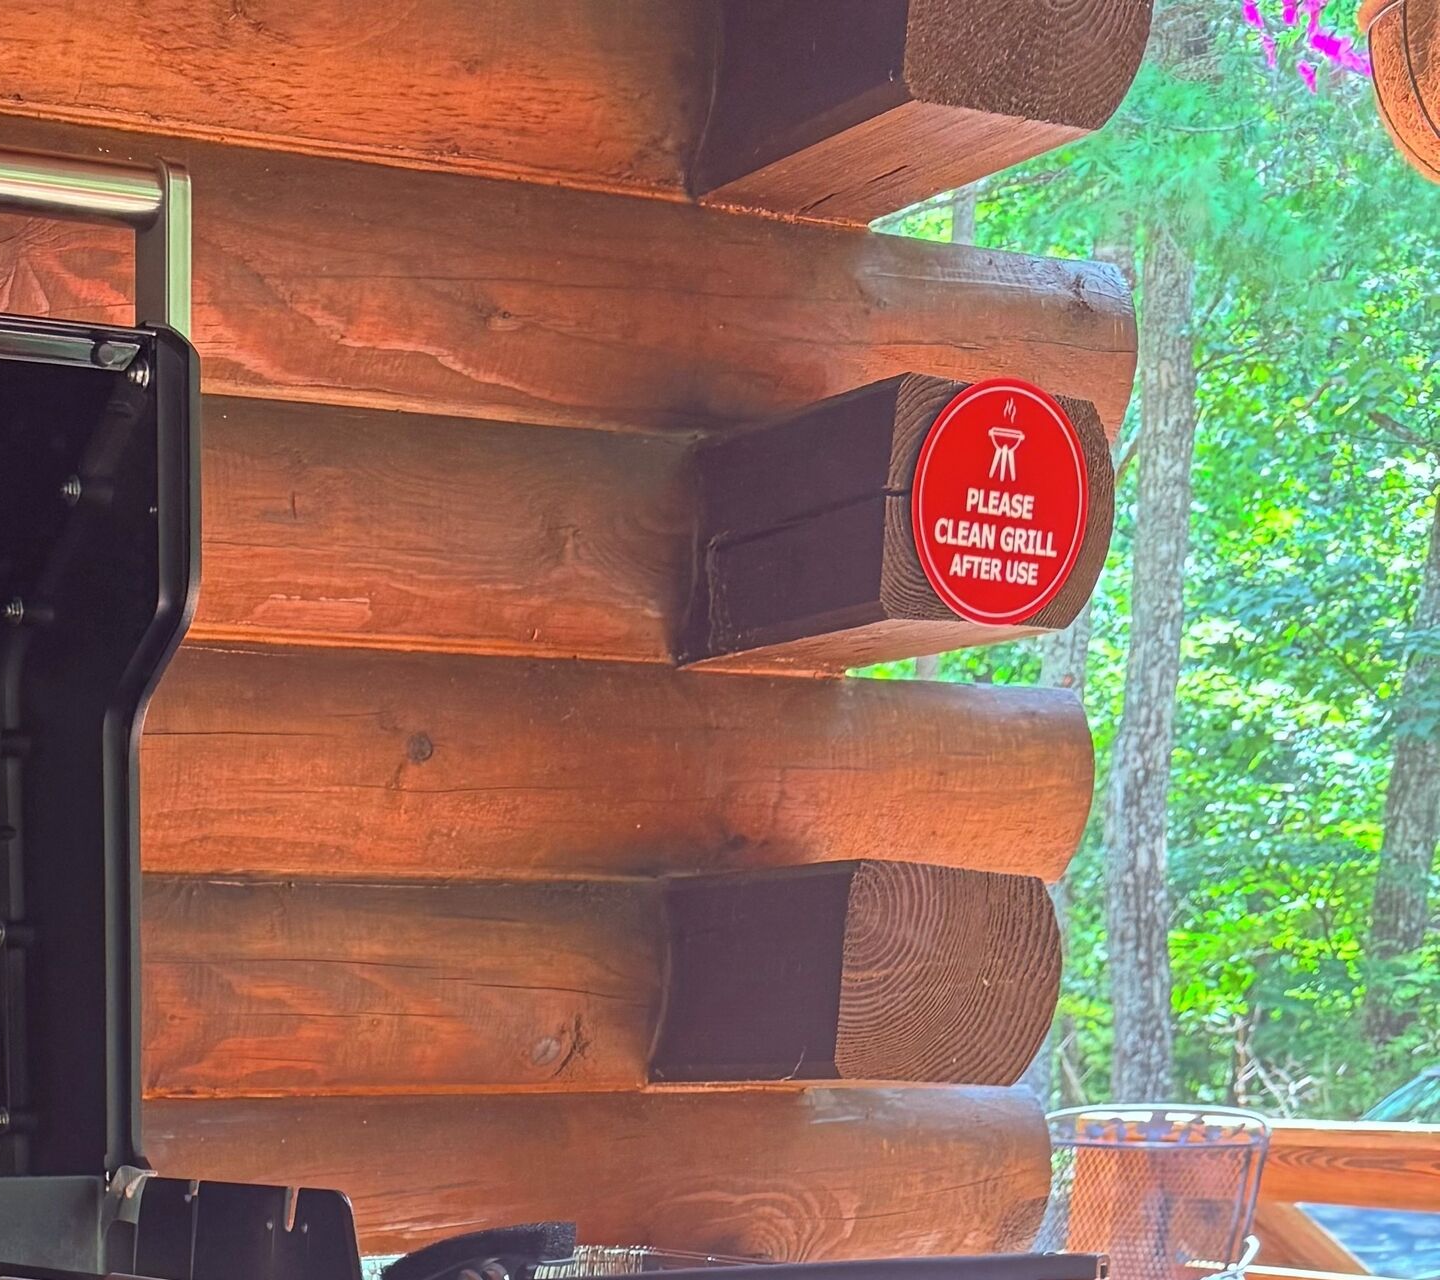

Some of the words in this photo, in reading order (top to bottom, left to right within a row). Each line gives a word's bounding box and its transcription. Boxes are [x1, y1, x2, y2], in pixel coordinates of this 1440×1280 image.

[966, 487, 1035, 520] PLEASE
[934, 518, 996, 550] CLEAN
[1000, 527, 1057, 558] GRILL
[949, 553, 1002, 582] AFTER
[1005, 561, 1039, 586] USE
